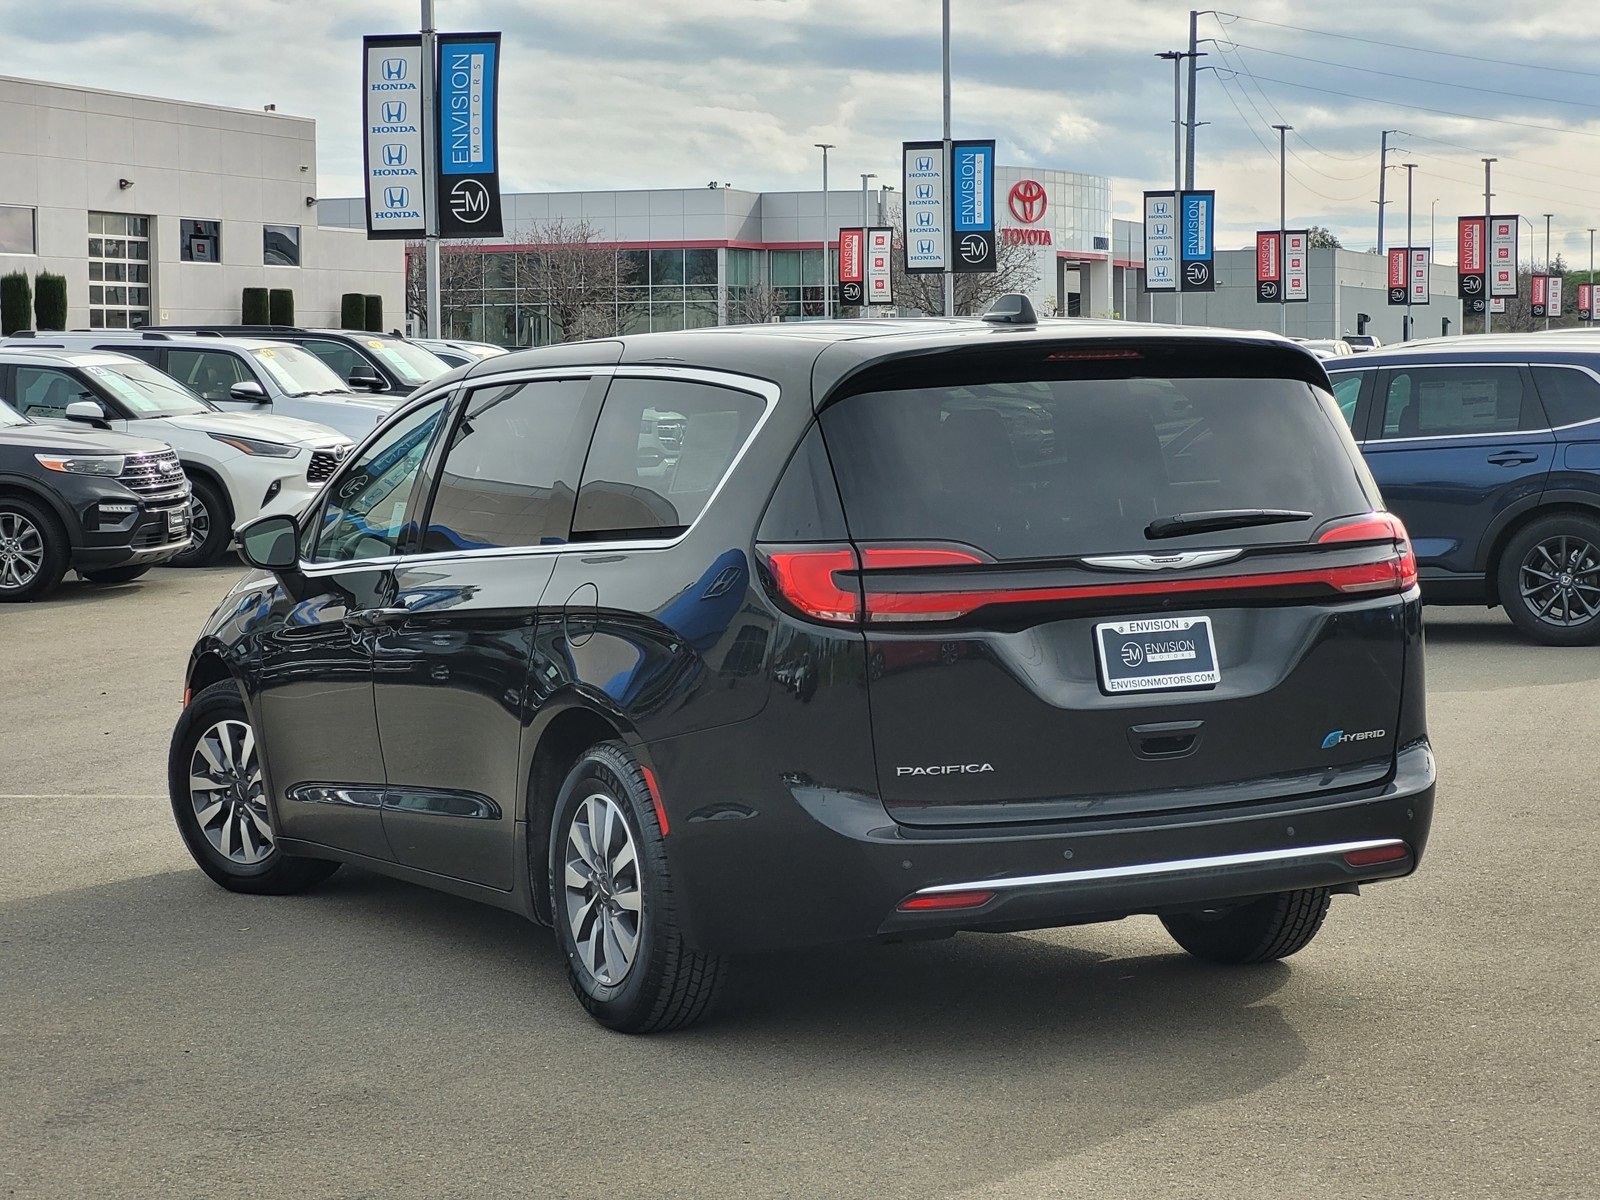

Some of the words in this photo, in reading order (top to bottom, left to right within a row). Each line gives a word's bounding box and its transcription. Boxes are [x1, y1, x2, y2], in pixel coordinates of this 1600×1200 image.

[452, 54, 470, 164] ENVISION
[962, 154, 974, 225] ENVISION
[1188, 200, 1198, 255] ENVISION
[1002, 228, 1052, 246] TOYOTA
[845, 235, 853, 278] ENVISION
[1130, 620, 1179, 632] ENVISION
[1144, 640, 1195, 654] ENVISION
[1111, 673, 1216, 689] ENVISIONMOTORS.COM
[1338, 730, 1385, 742] HYBRID
[896, 763, 994, 776] PACIFICA
